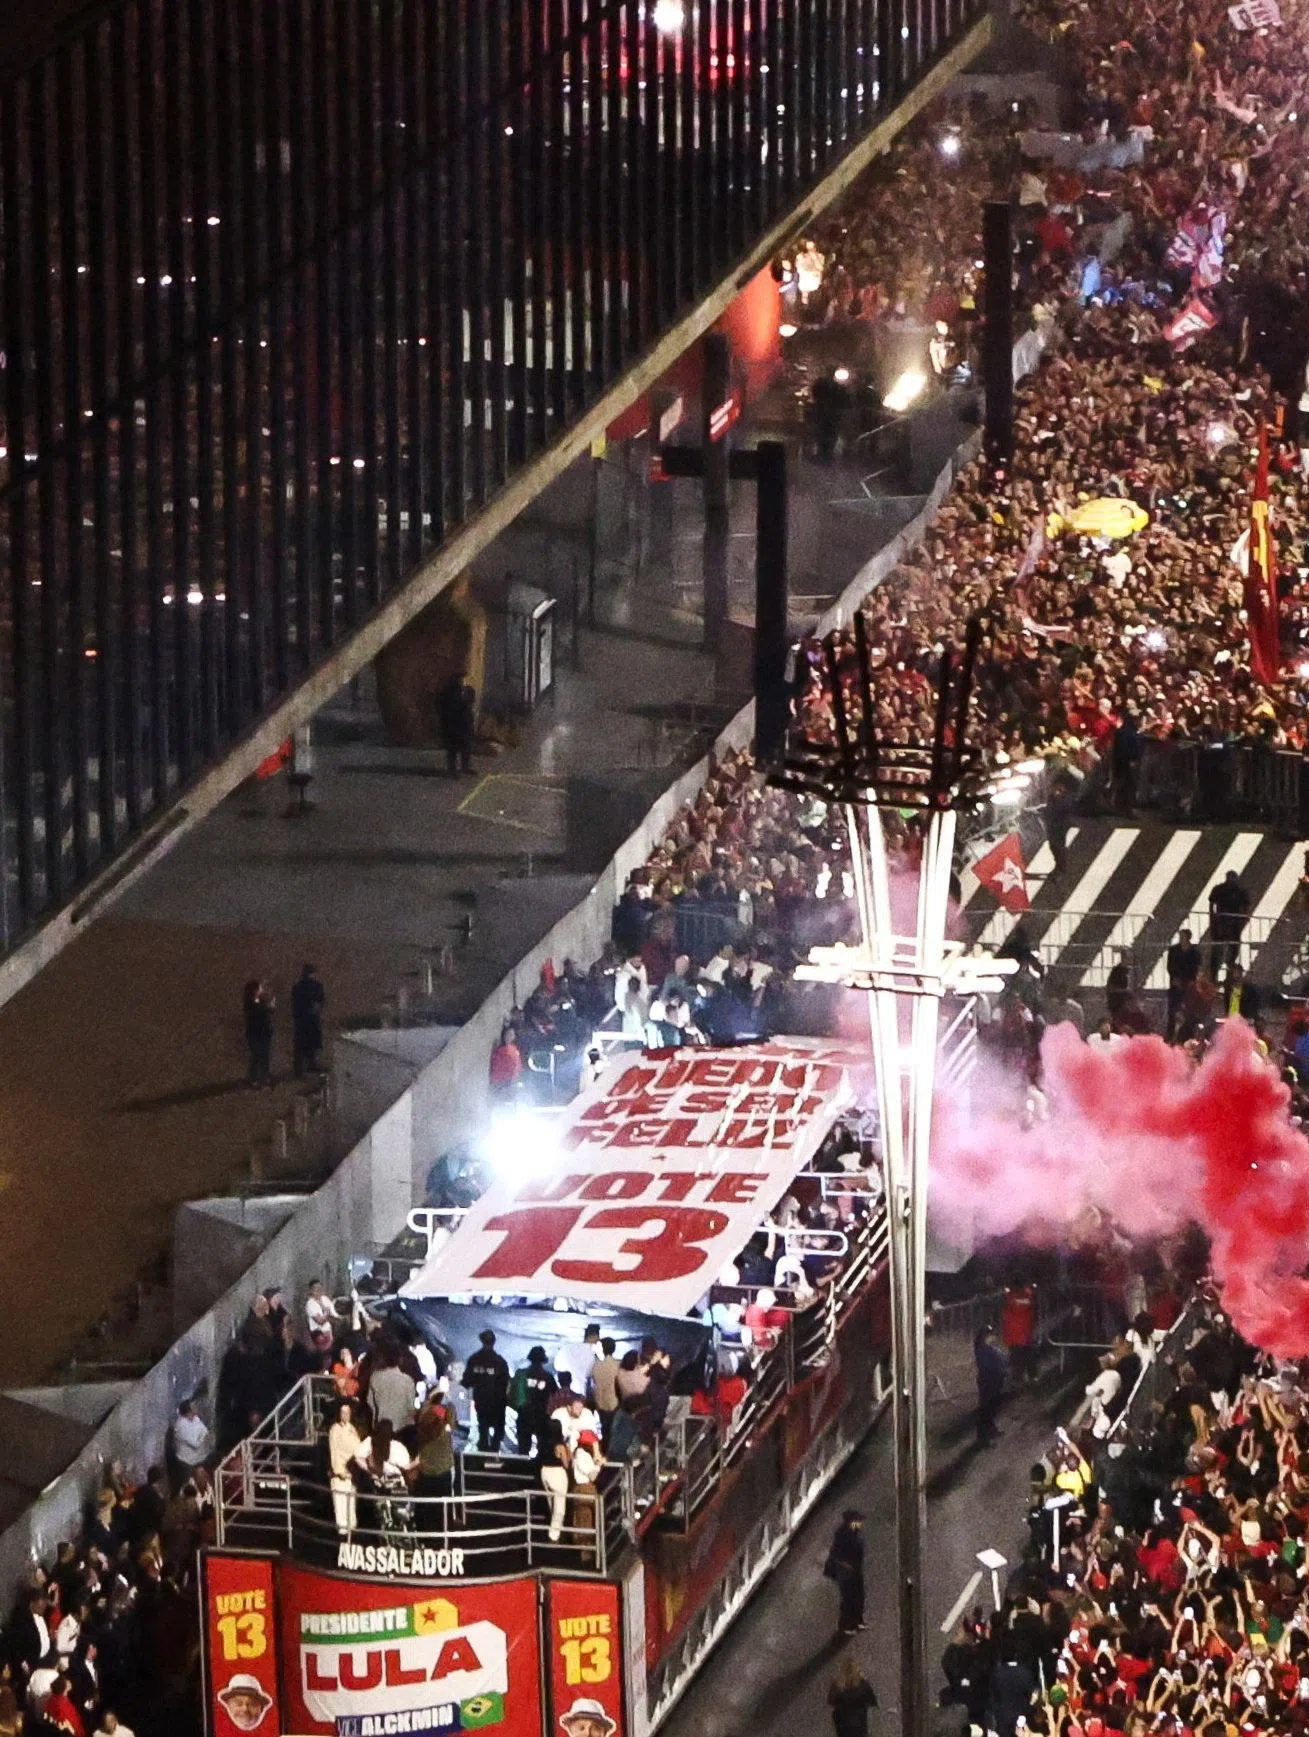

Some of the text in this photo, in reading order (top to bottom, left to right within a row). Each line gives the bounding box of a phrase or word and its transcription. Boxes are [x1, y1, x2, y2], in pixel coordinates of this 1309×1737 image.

[515, 1171, 769, 1202] VOTE
[469, 1206, 729, 1283] 13
[338, 1542, 465, 1576] AVASSALADOR
[216, 1589, 267, 1615] VOTE
[217, 1612, 268, 1661] 13
[300, 1607, 409, 1635] PRESIDENTE
[559, 1613, 612, 1639] VOTE
[305, 1636, 484, 1694] LULA
[559, 1636, 612, 1686] 13
[361, 1703, 455, 1736] ALCKMIN
